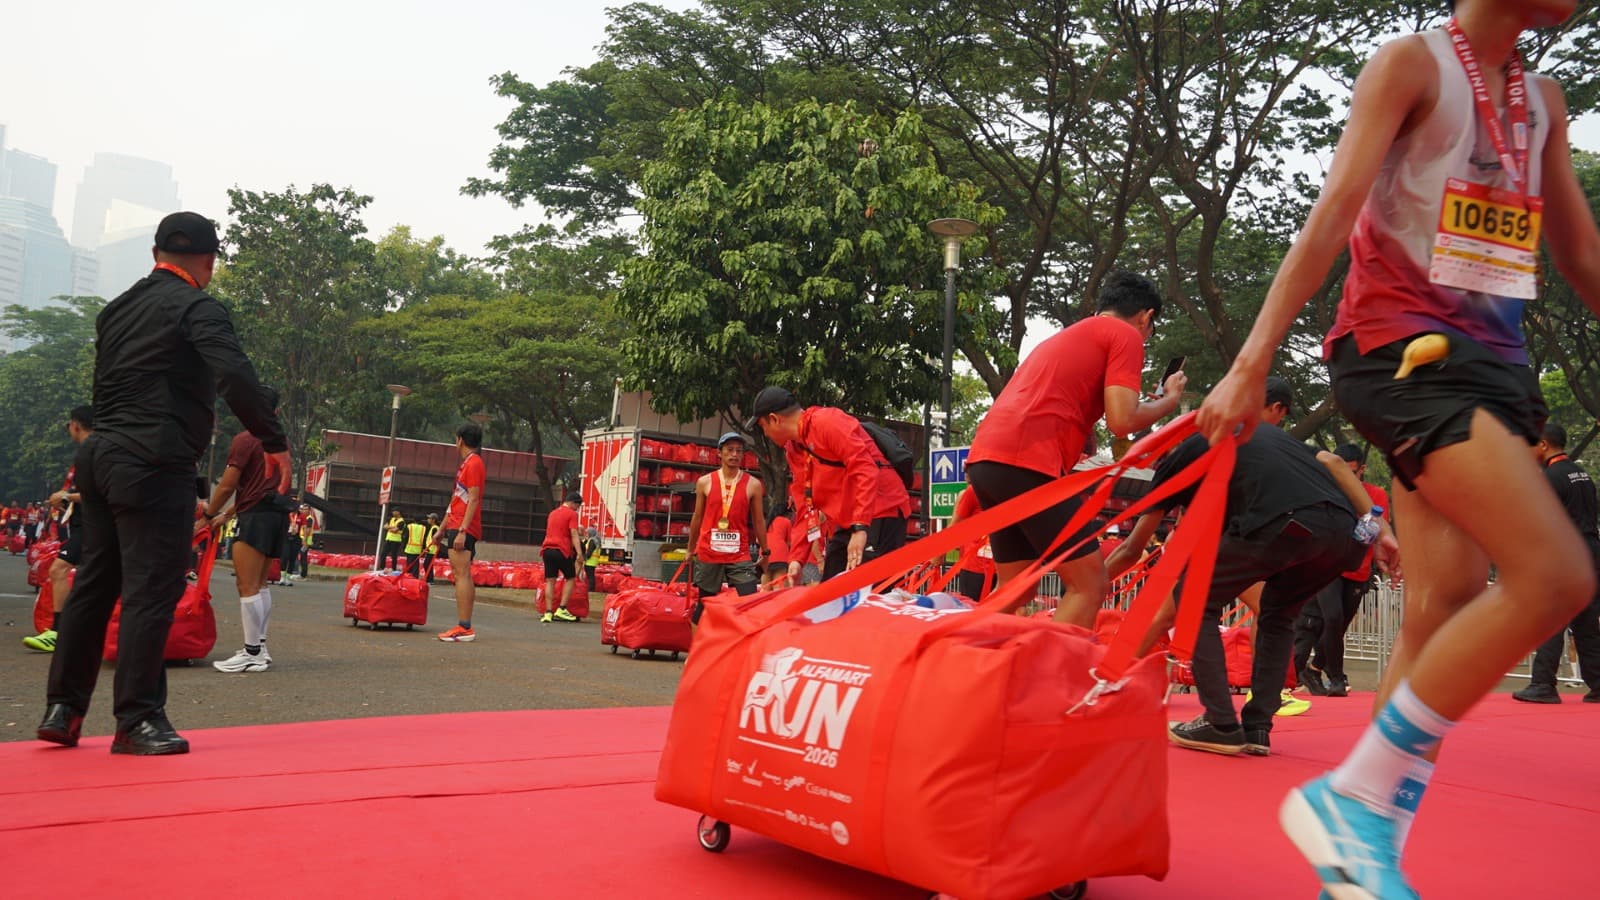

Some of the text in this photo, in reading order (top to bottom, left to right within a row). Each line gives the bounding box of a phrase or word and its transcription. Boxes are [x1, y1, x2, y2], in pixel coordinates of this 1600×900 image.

[1452, 33, 1489, 102] FINISHER
[1508, 80, 1525, 107] 10K
[1453, 200, 1530, 241] 10659
[715, 532, 737, 541] 51100
[797, 664, 872, 686] ALFAMART
[739, 671, 863, 751] RUN
[803, 746, 839, 768] 2026
